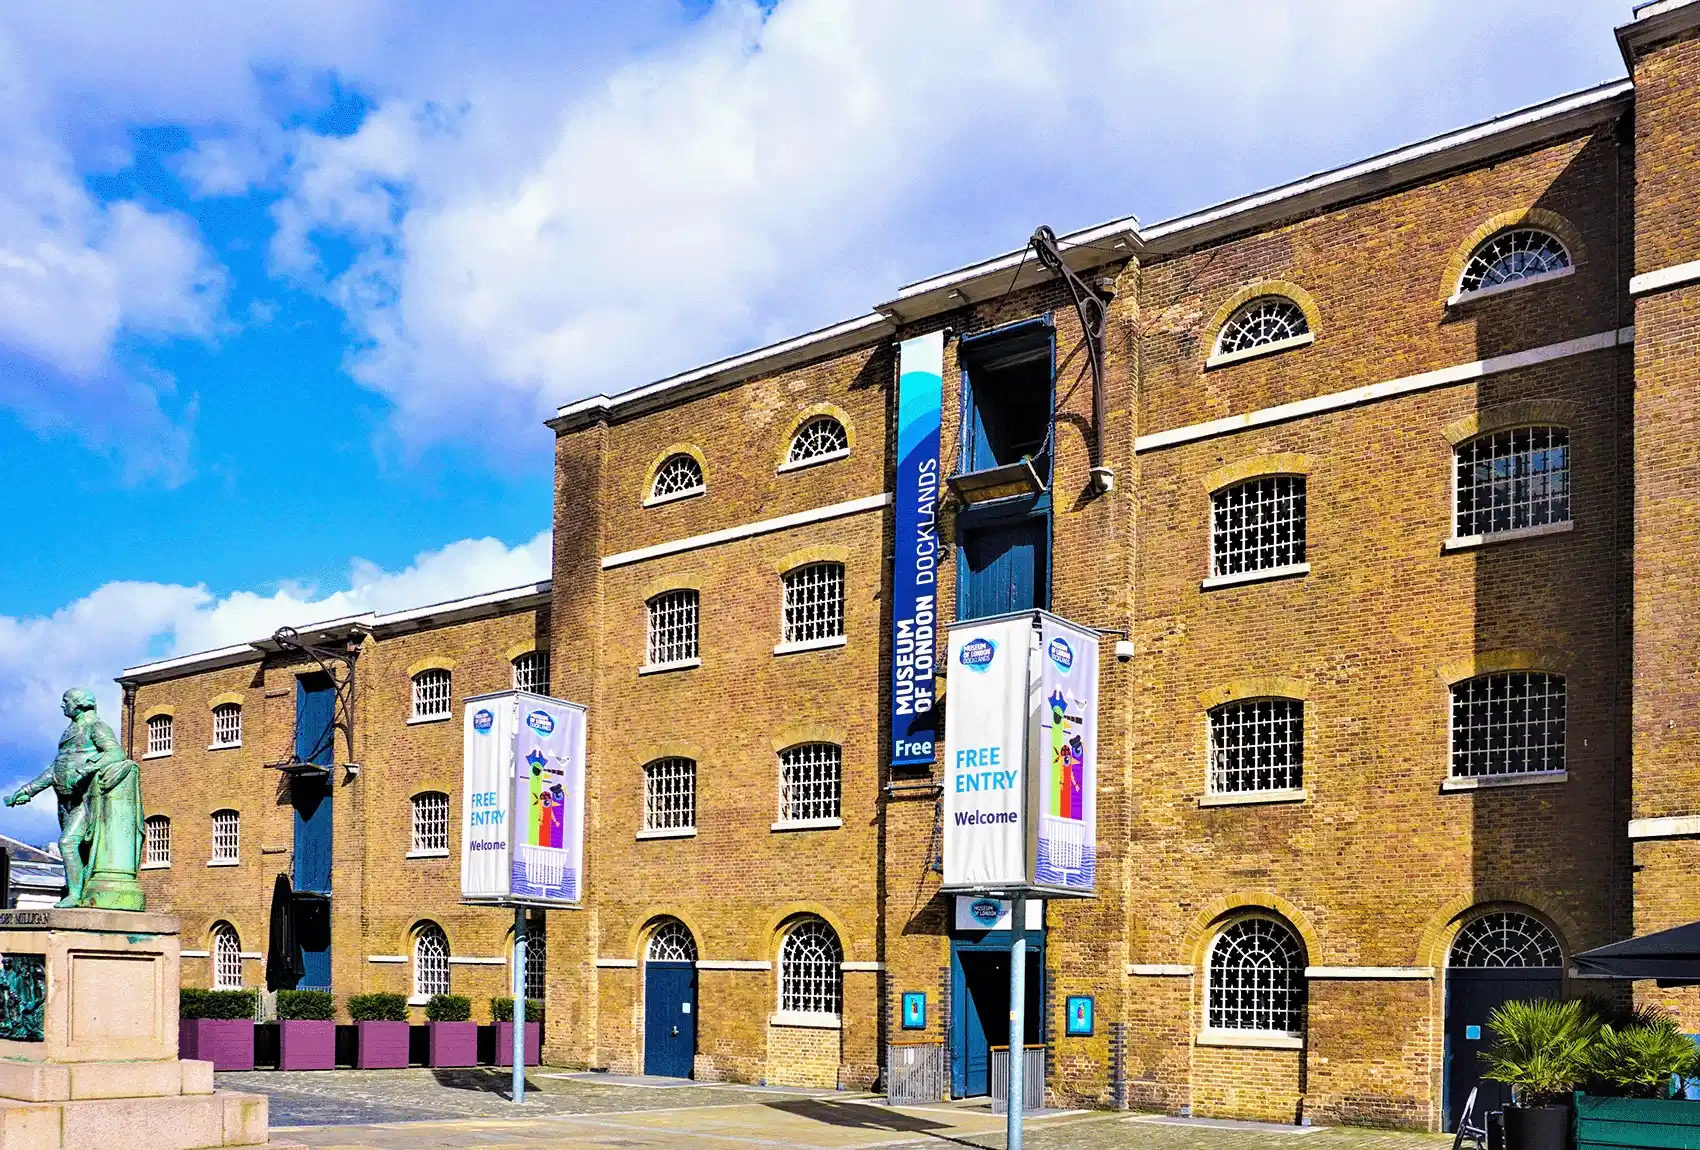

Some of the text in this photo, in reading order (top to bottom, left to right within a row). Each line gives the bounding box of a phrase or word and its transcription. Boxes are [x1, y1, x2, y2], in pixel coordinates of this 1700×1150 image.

[914, 458, 937, 713] OF LONDON DOCKLANDS
[896, 618, 914, 715] MUSEUM
[895, 740, 932, 757] Free
[956, 747, 1000, 768] FREE
[956, 770, 1018, 793] ENTRY
[471, 791, 496, 808] FREE
[471, 809, 506, 826] ENTRY
[954, 809, 1018, 826] Welcome
[470, 839, 506, 851] Welcome
